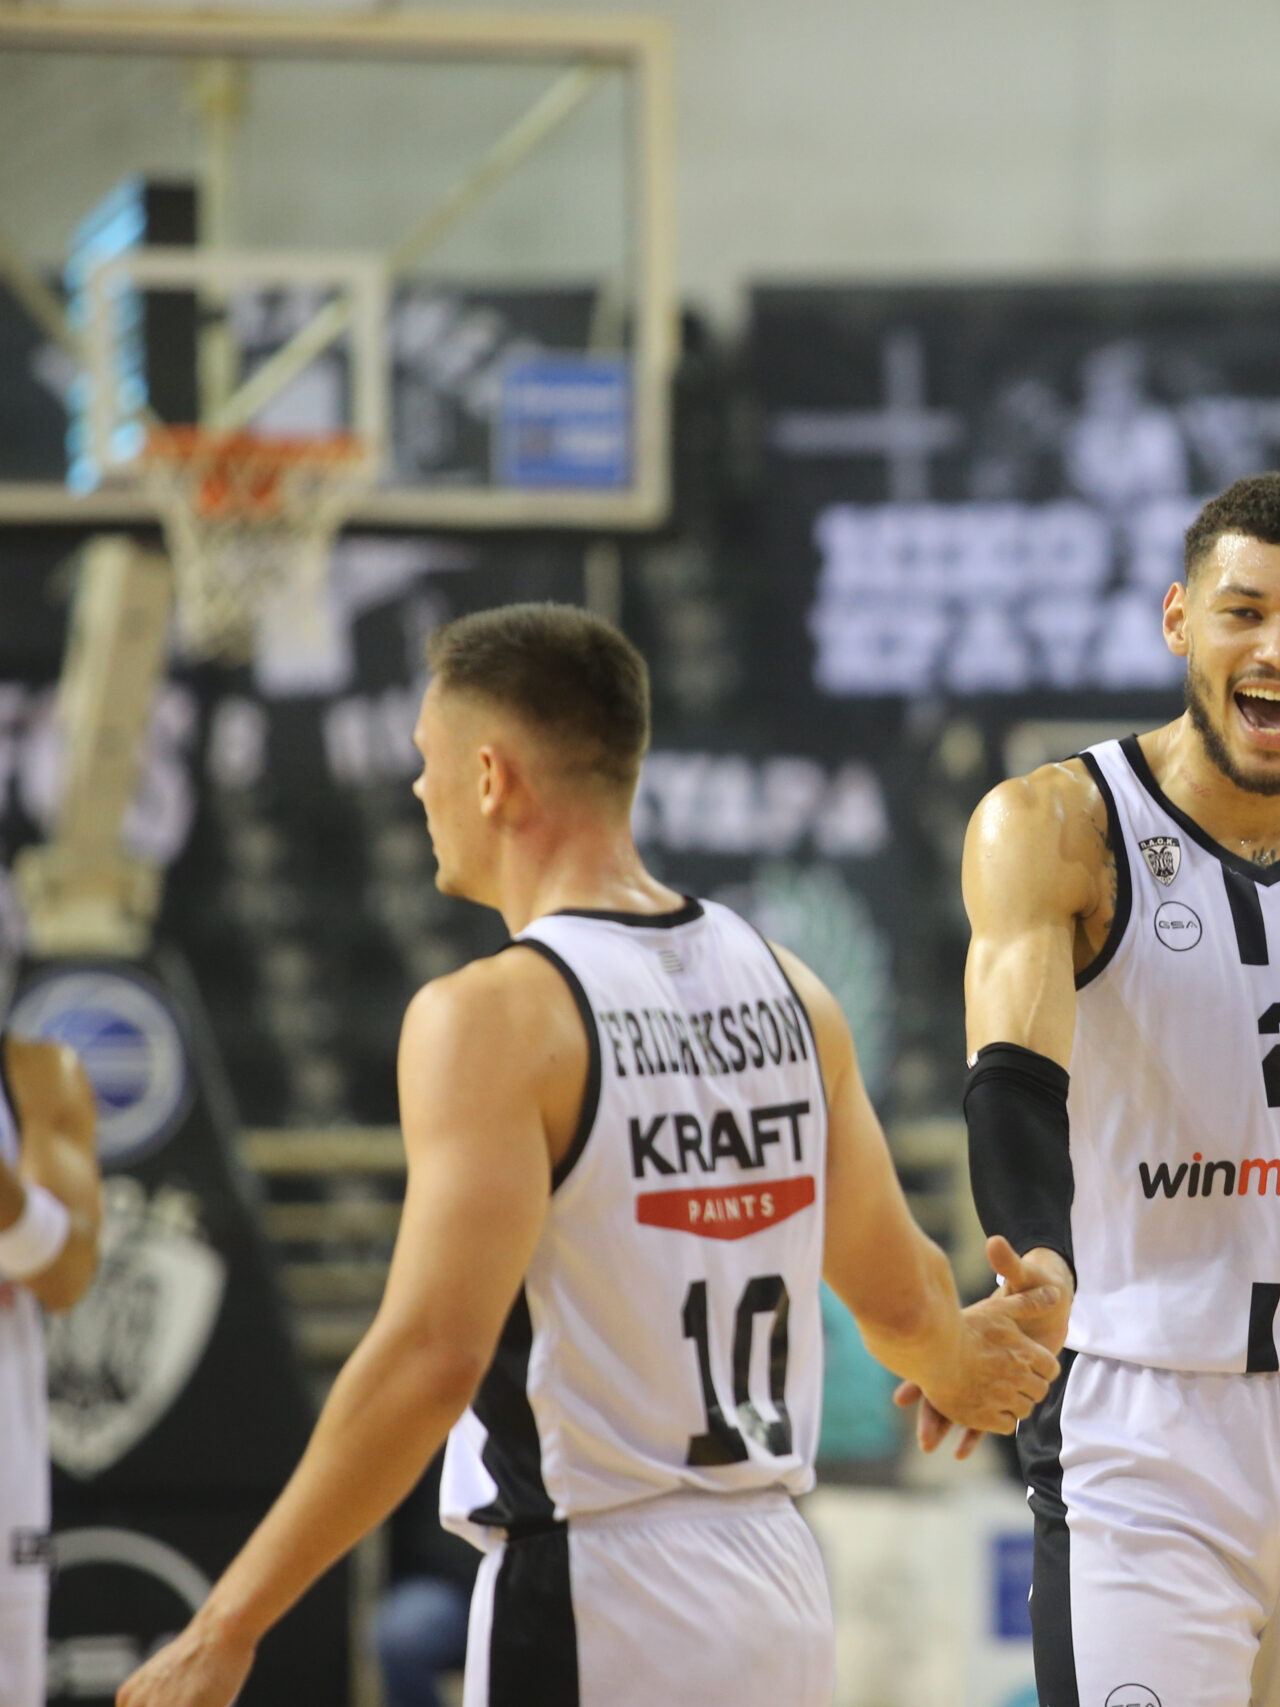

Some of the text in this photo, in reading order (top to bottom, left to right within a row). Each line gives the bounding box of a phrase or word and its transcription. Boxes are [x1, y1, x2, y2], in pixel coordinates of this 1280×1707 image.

[628, 1101, 810, 1179] KRAFT
[687, 1193, 775, 1223] PAINTS
[681, 1274, 793, 1467] 10
